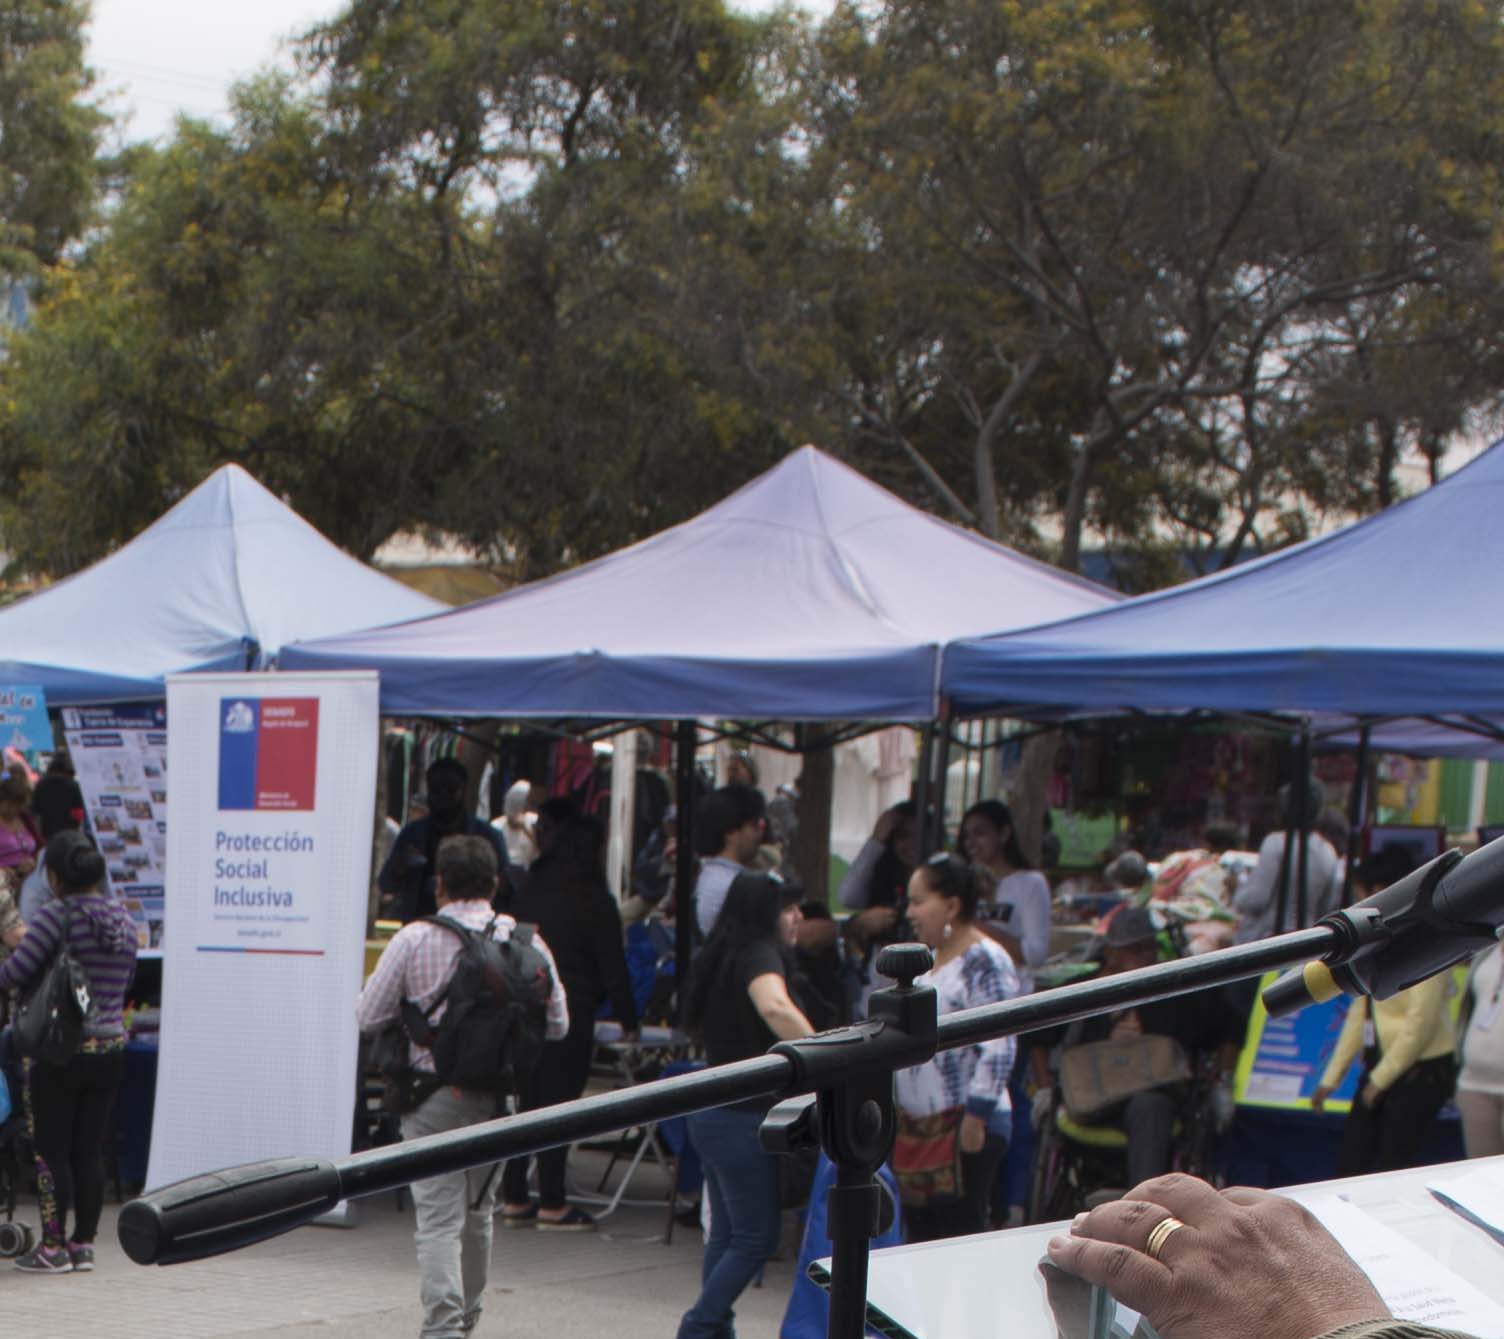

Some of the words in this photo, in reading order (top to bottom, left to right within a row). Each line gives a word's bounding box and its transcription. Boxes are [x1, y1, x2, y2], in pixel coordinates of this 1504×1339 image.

[215, 830, 314, 852] Protección
[214, 858, 268, 879] Social
[214, 887, 293, 907] Inclusiva
